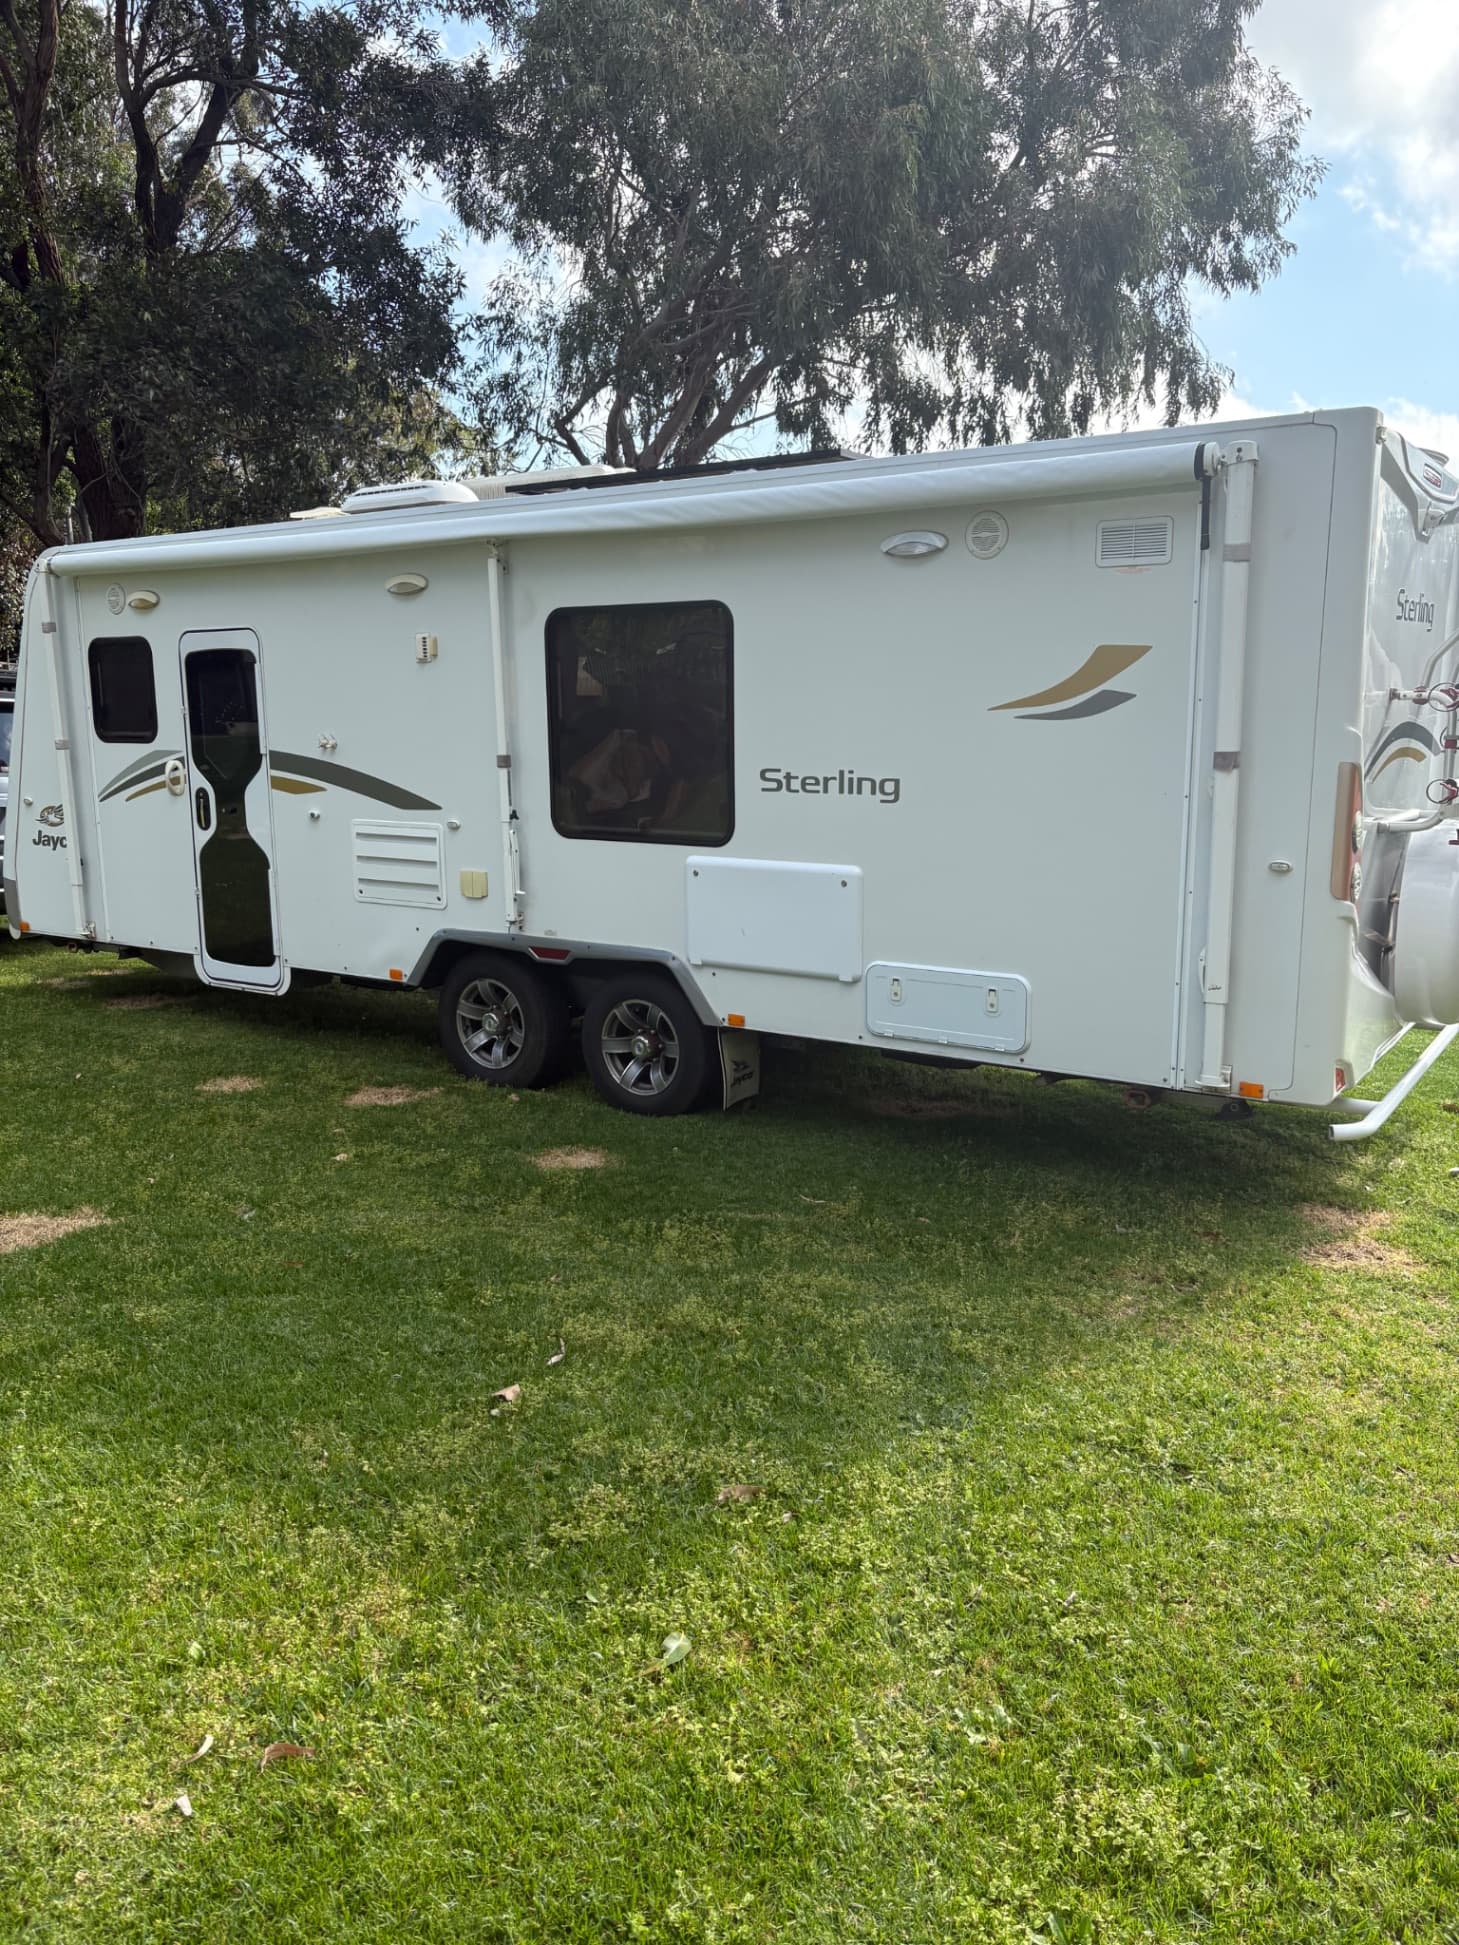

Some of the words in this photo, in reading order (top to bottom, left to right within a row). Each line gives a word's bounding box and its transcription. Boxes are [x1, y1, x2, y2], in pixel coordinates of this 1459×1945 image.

[1396, 588, 1435, 632] Sterling
[759, 768, 900, 804] Sterling
[32, 829, 68, 851] Jayc
